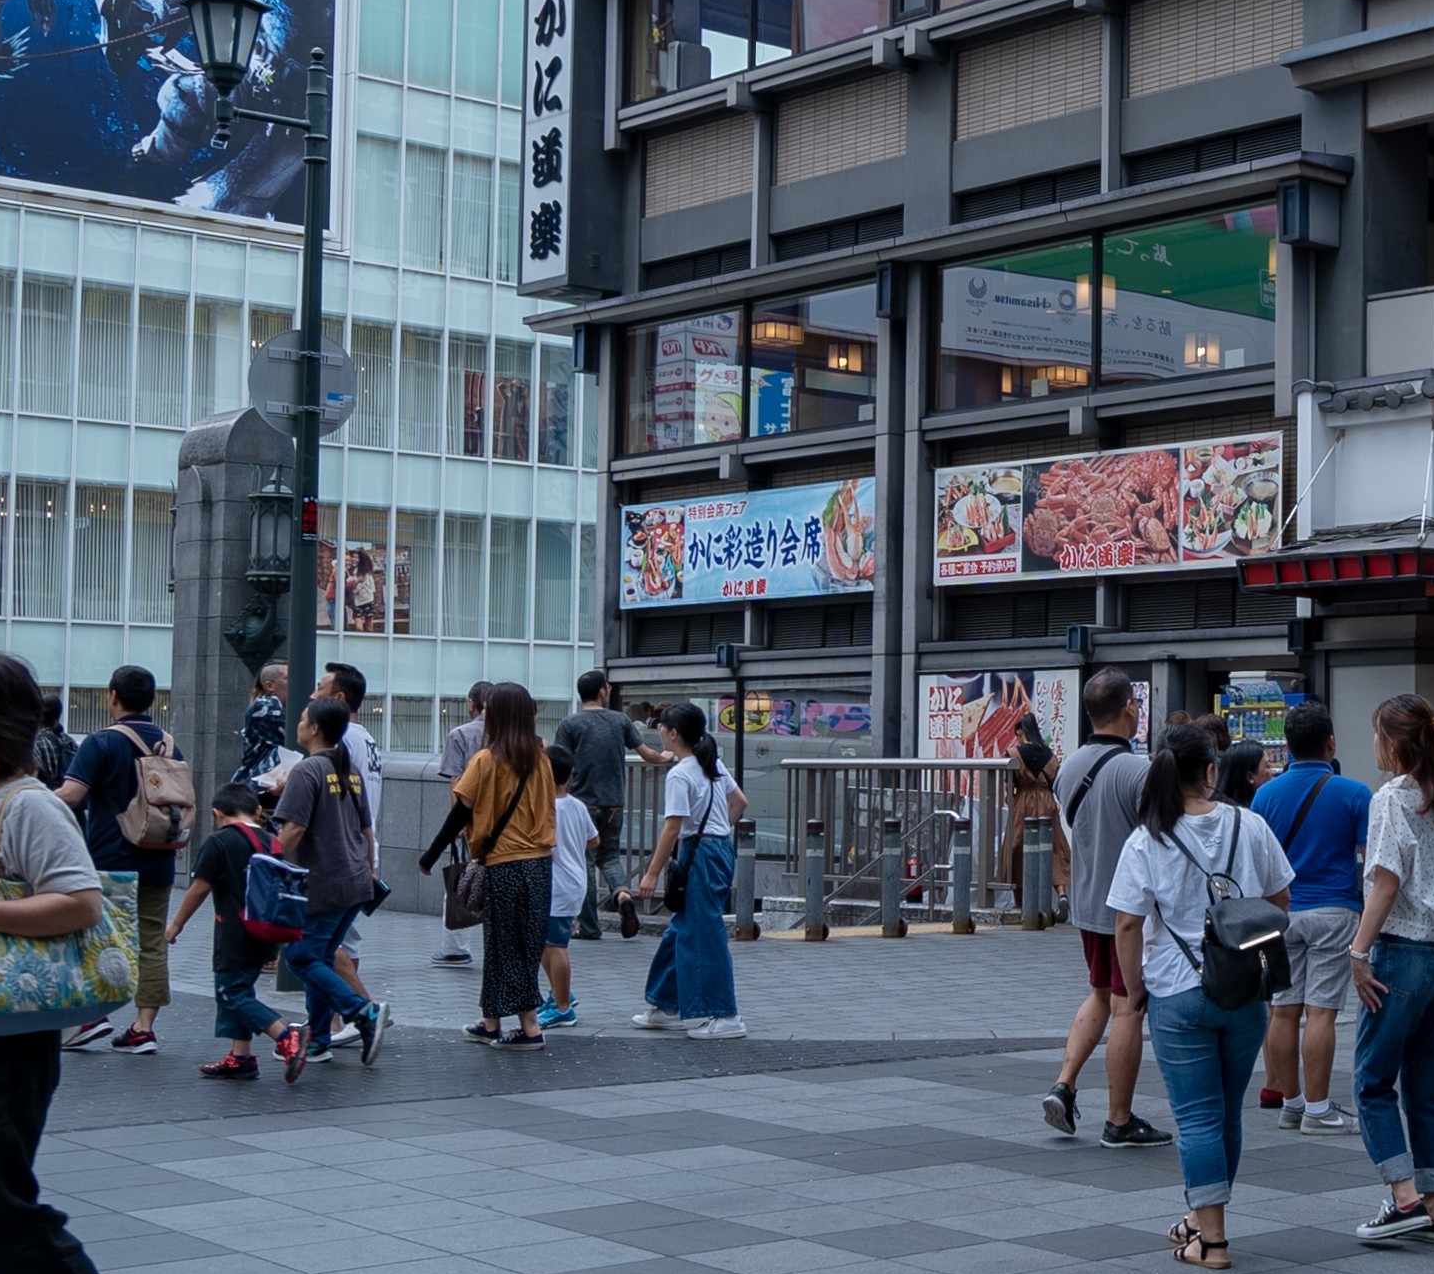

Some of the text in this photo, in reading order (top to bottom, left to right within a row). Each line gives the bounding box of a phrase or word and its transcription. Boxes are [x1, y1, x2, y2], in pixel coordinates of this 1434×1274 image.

[689, 500, 747, 521] 特別会席フェア
[689, 515, 822, 572] かに彩造り会席
